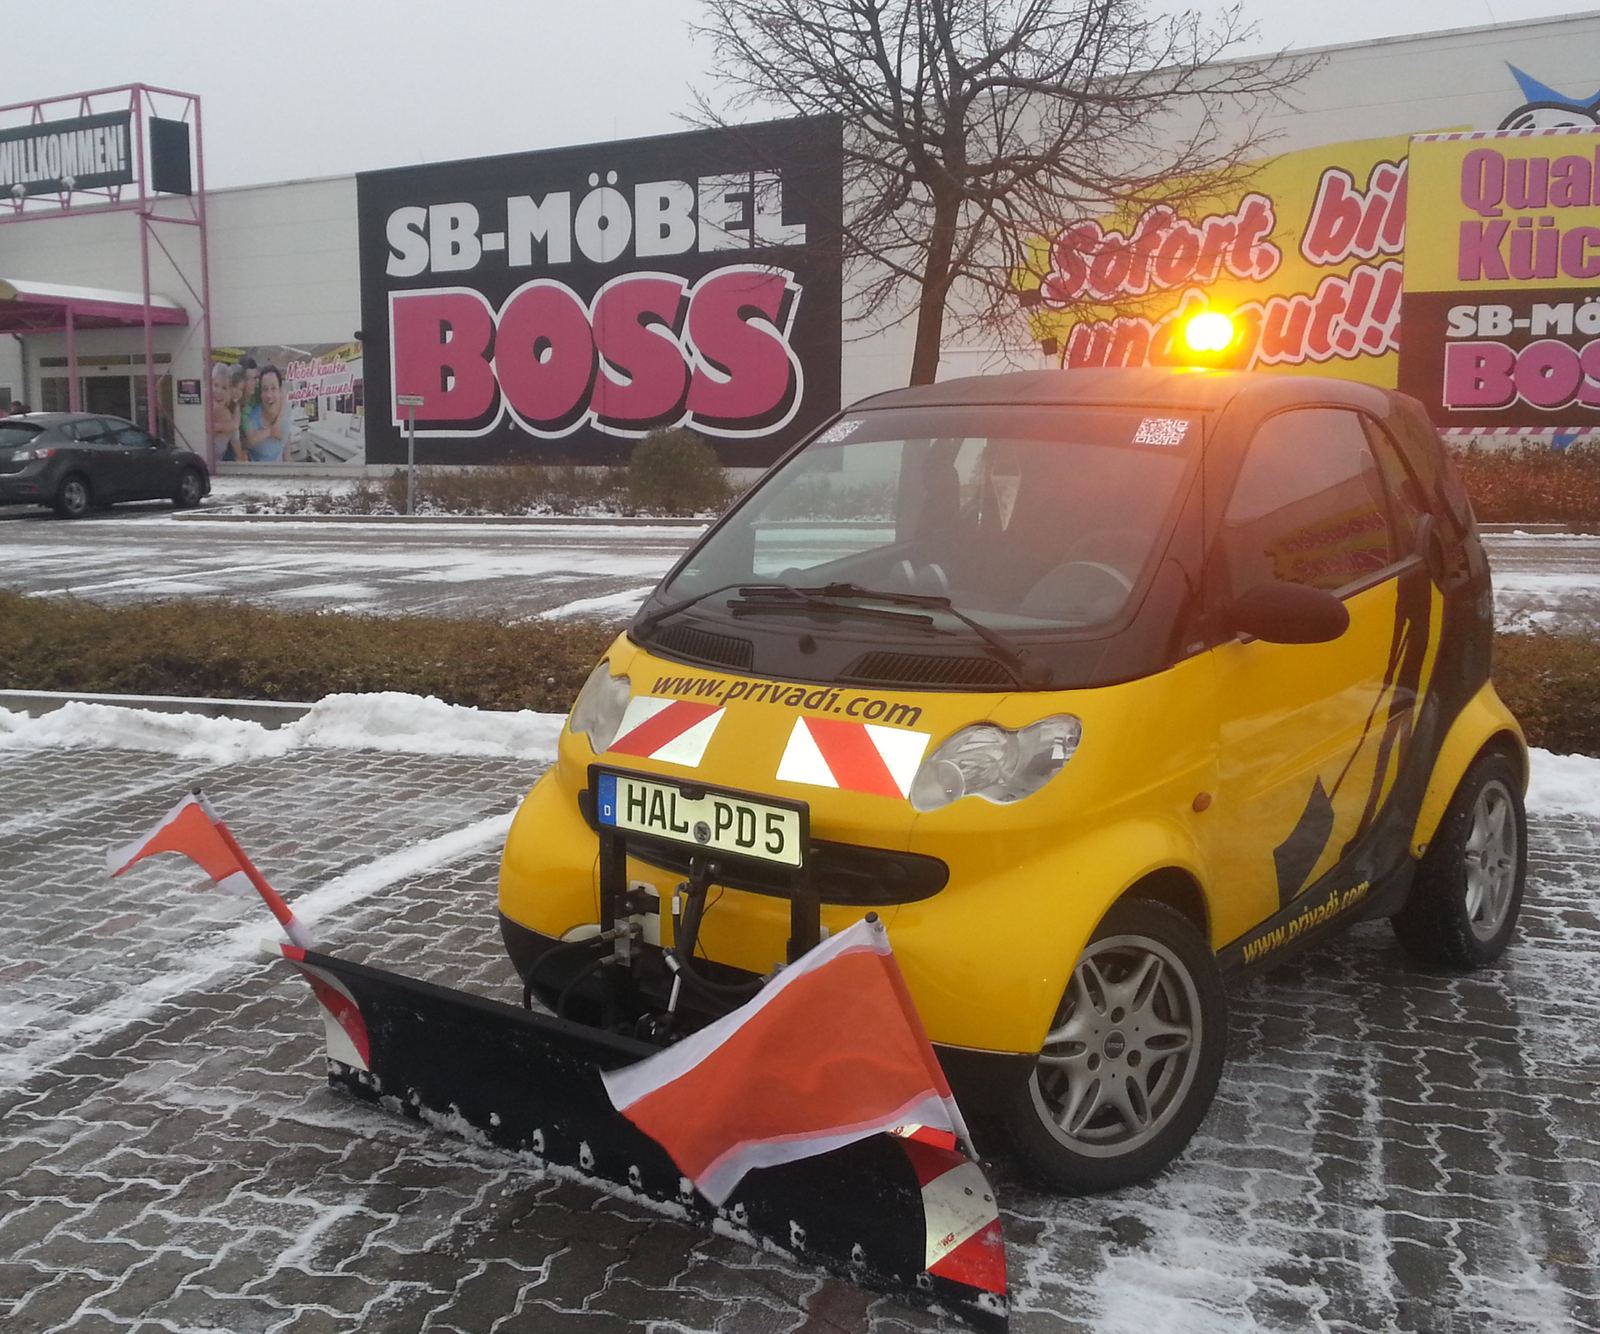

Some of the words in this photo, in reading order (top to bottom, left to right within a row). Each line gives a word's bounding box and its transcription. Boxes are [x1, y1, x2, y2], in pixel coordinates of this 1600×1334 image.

[0, 124, 125, 186] WILLKOMMEN!
[1461, 144, 1600, 217] Qua
[386, 168, 806, 277] SB-MÖBEL
[1458, 216, 1600, 281] Küc
[1446, 297, 1600, 337] SB-MÖ
[388, 263, 803, 438] BOSS
[652, 677, 922, 727] www.privadi.com
[627, 784, 689, 833] HAL
[1242, 880, 1370, 963] www.privadi.com
